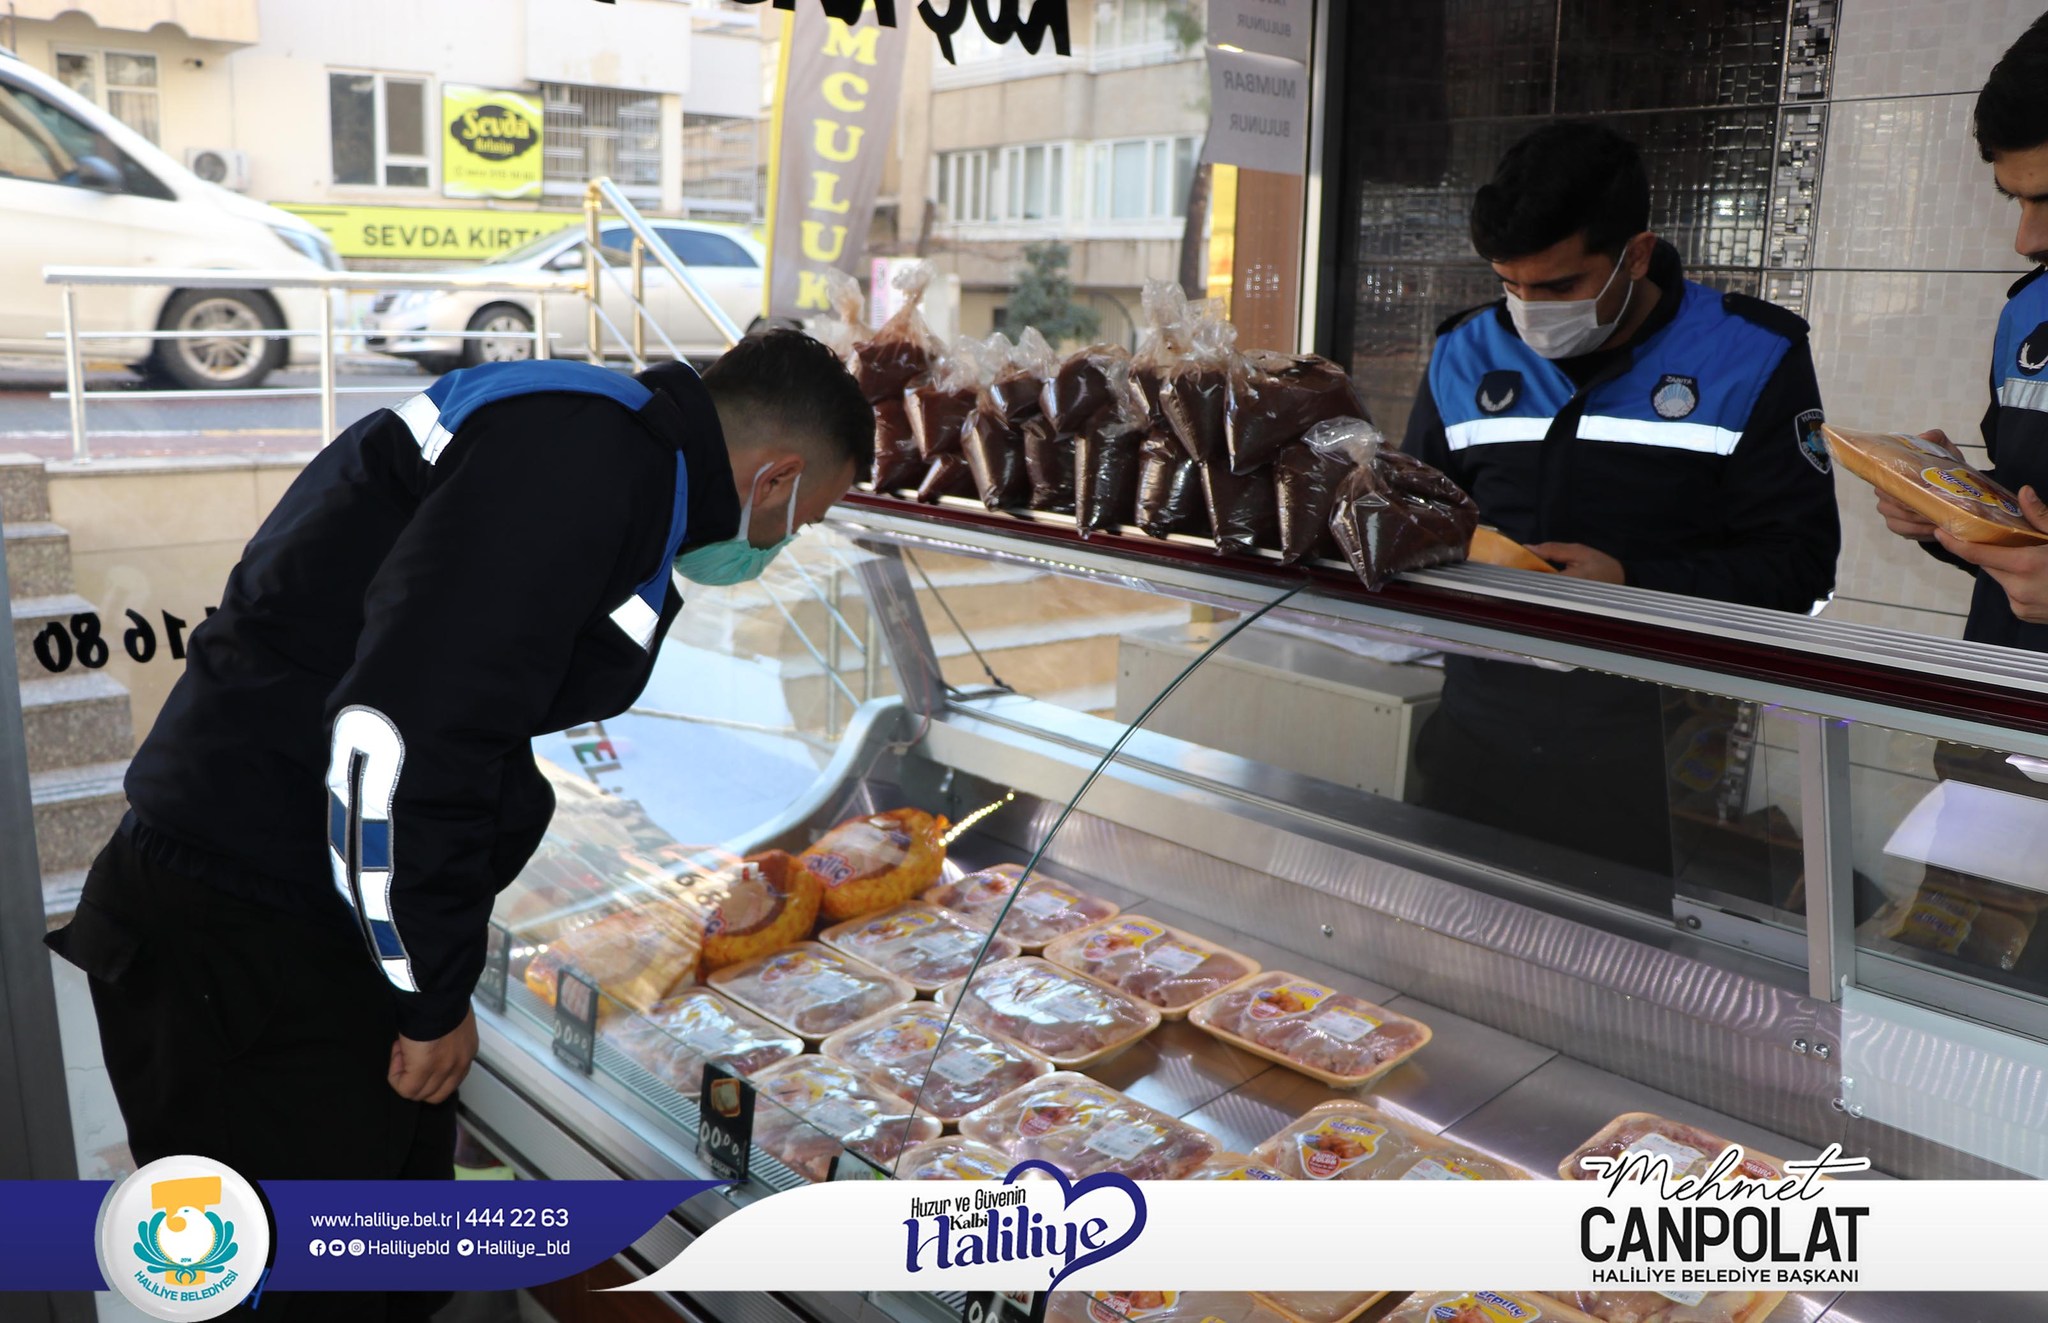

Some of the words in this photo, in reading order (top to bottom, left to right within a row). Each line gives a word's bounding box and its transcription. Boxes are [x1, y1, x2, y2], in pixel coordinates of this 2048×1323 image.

[363, 224, 460, 248] SEVDA
[468, 226, 541, 249] KIRT
[795, 0, 881, 311] MCULUK
